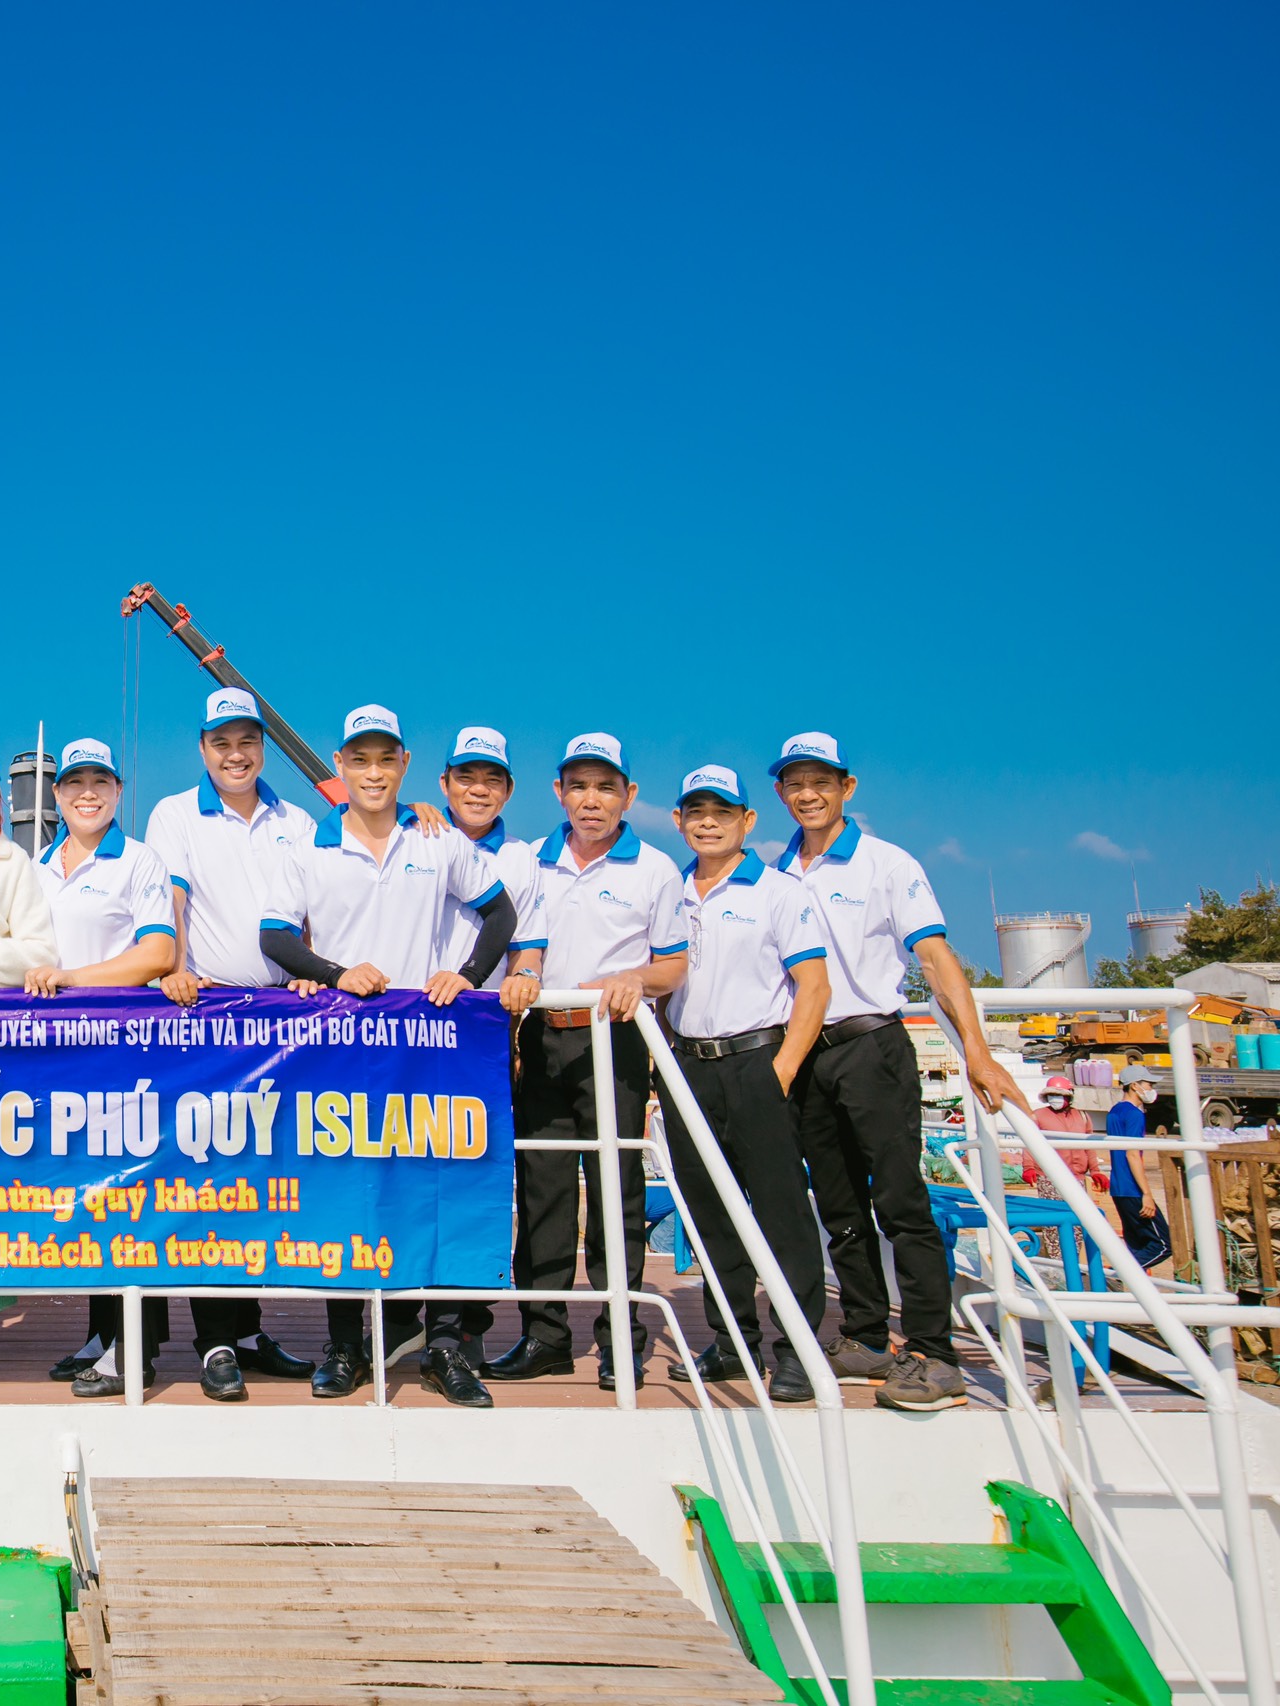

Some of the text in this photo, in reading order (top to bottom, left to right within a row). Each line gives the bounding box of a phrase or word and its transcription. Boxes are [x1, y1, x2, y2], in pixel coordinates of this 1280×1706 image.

[52, 1013, 119, 1046] THÔNG
[125, 1016, 154, 1051] SỰ
[158, 1012, 205, 1051] KIỆN
[211, 1012, 238, 1046] VÀ
[243, 1018, 271, 1046] DU
[277, 1017, 322, 1052] LỊCH
[328, 1011, 356, 1046] BỜ
[361, 1012, 399, 1046] CÁT
[404, 1012, 457, 1048] VÀNG
[50, 1078, 160, 1158] PHÚ
[175, 1078, 282, 1163] QUÝ
[296, 1090, 487, 1159] ISLAND
[83, 1179, 147, 1222] quý
[154, 1177, 259, 1213] khách
[267, 1177, 300, 1212] !!!
[110, 1233, 158, 1268] tin
[165, 1230, 267, 1276] tưởng
[274, 1230, 343, 1278] ủng
[350, 1233, 394, 1279] hộ
